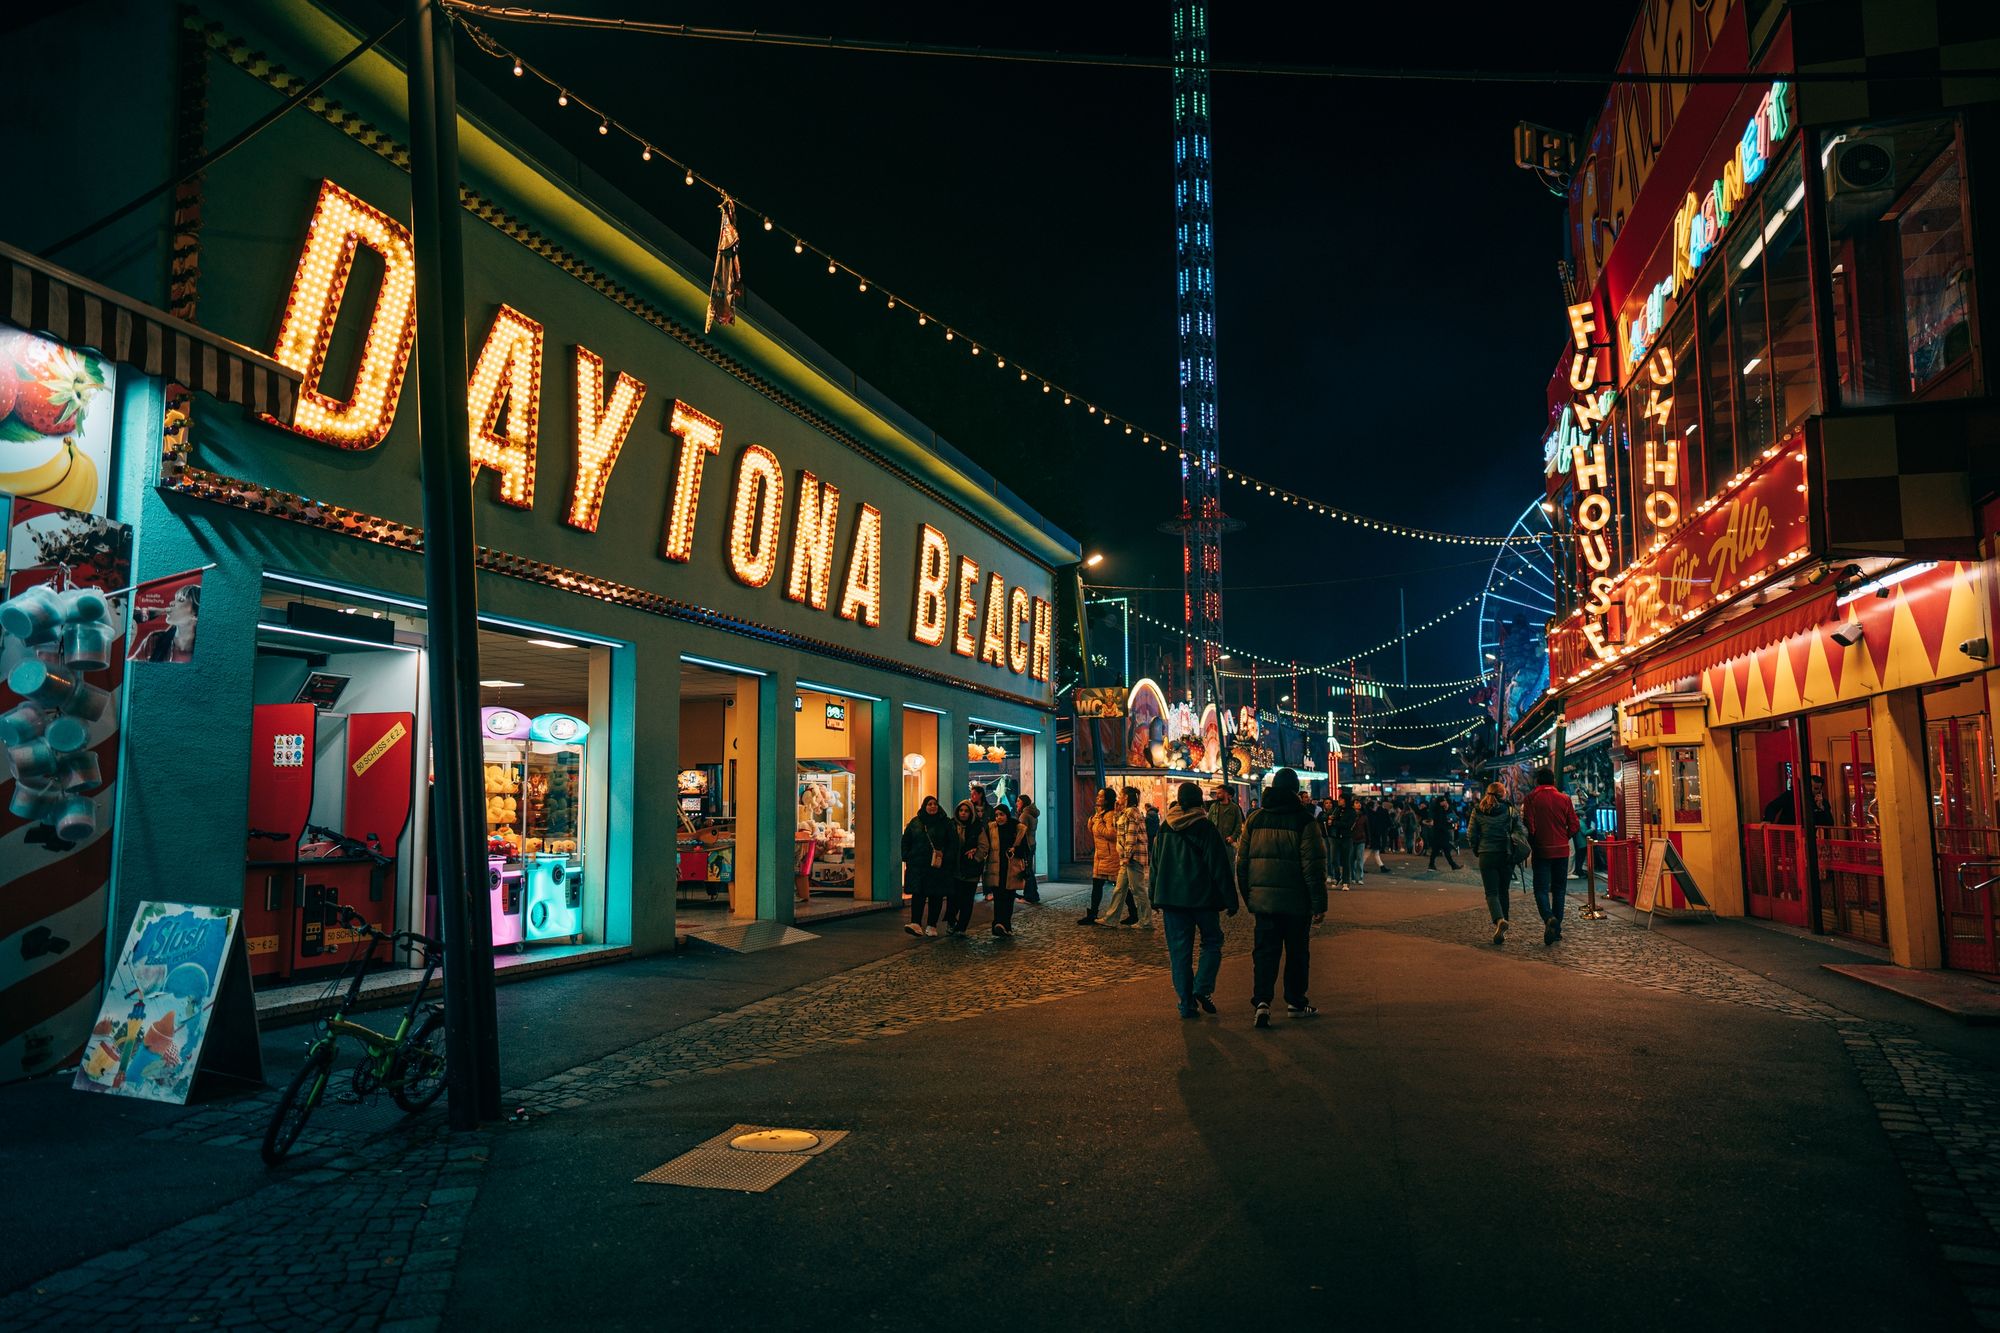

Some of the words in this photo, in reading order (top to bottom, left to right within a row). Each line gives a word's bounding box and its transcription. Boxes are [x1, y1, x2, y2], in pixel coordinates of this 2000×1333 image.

[258, 178, 882, 627] DAYTONA
[911, 522, 1055, 686] BEACH
[1567, 300, 1618, 660] FUNHOUSE
[1667, 547, 1699, 615] für
[1708, 497, 1772, 595] Alle
[356, 761, 365, 772] 50
[364, 741, 387, 765] SCHUSS
[147, 919, 210, 958] Slush
